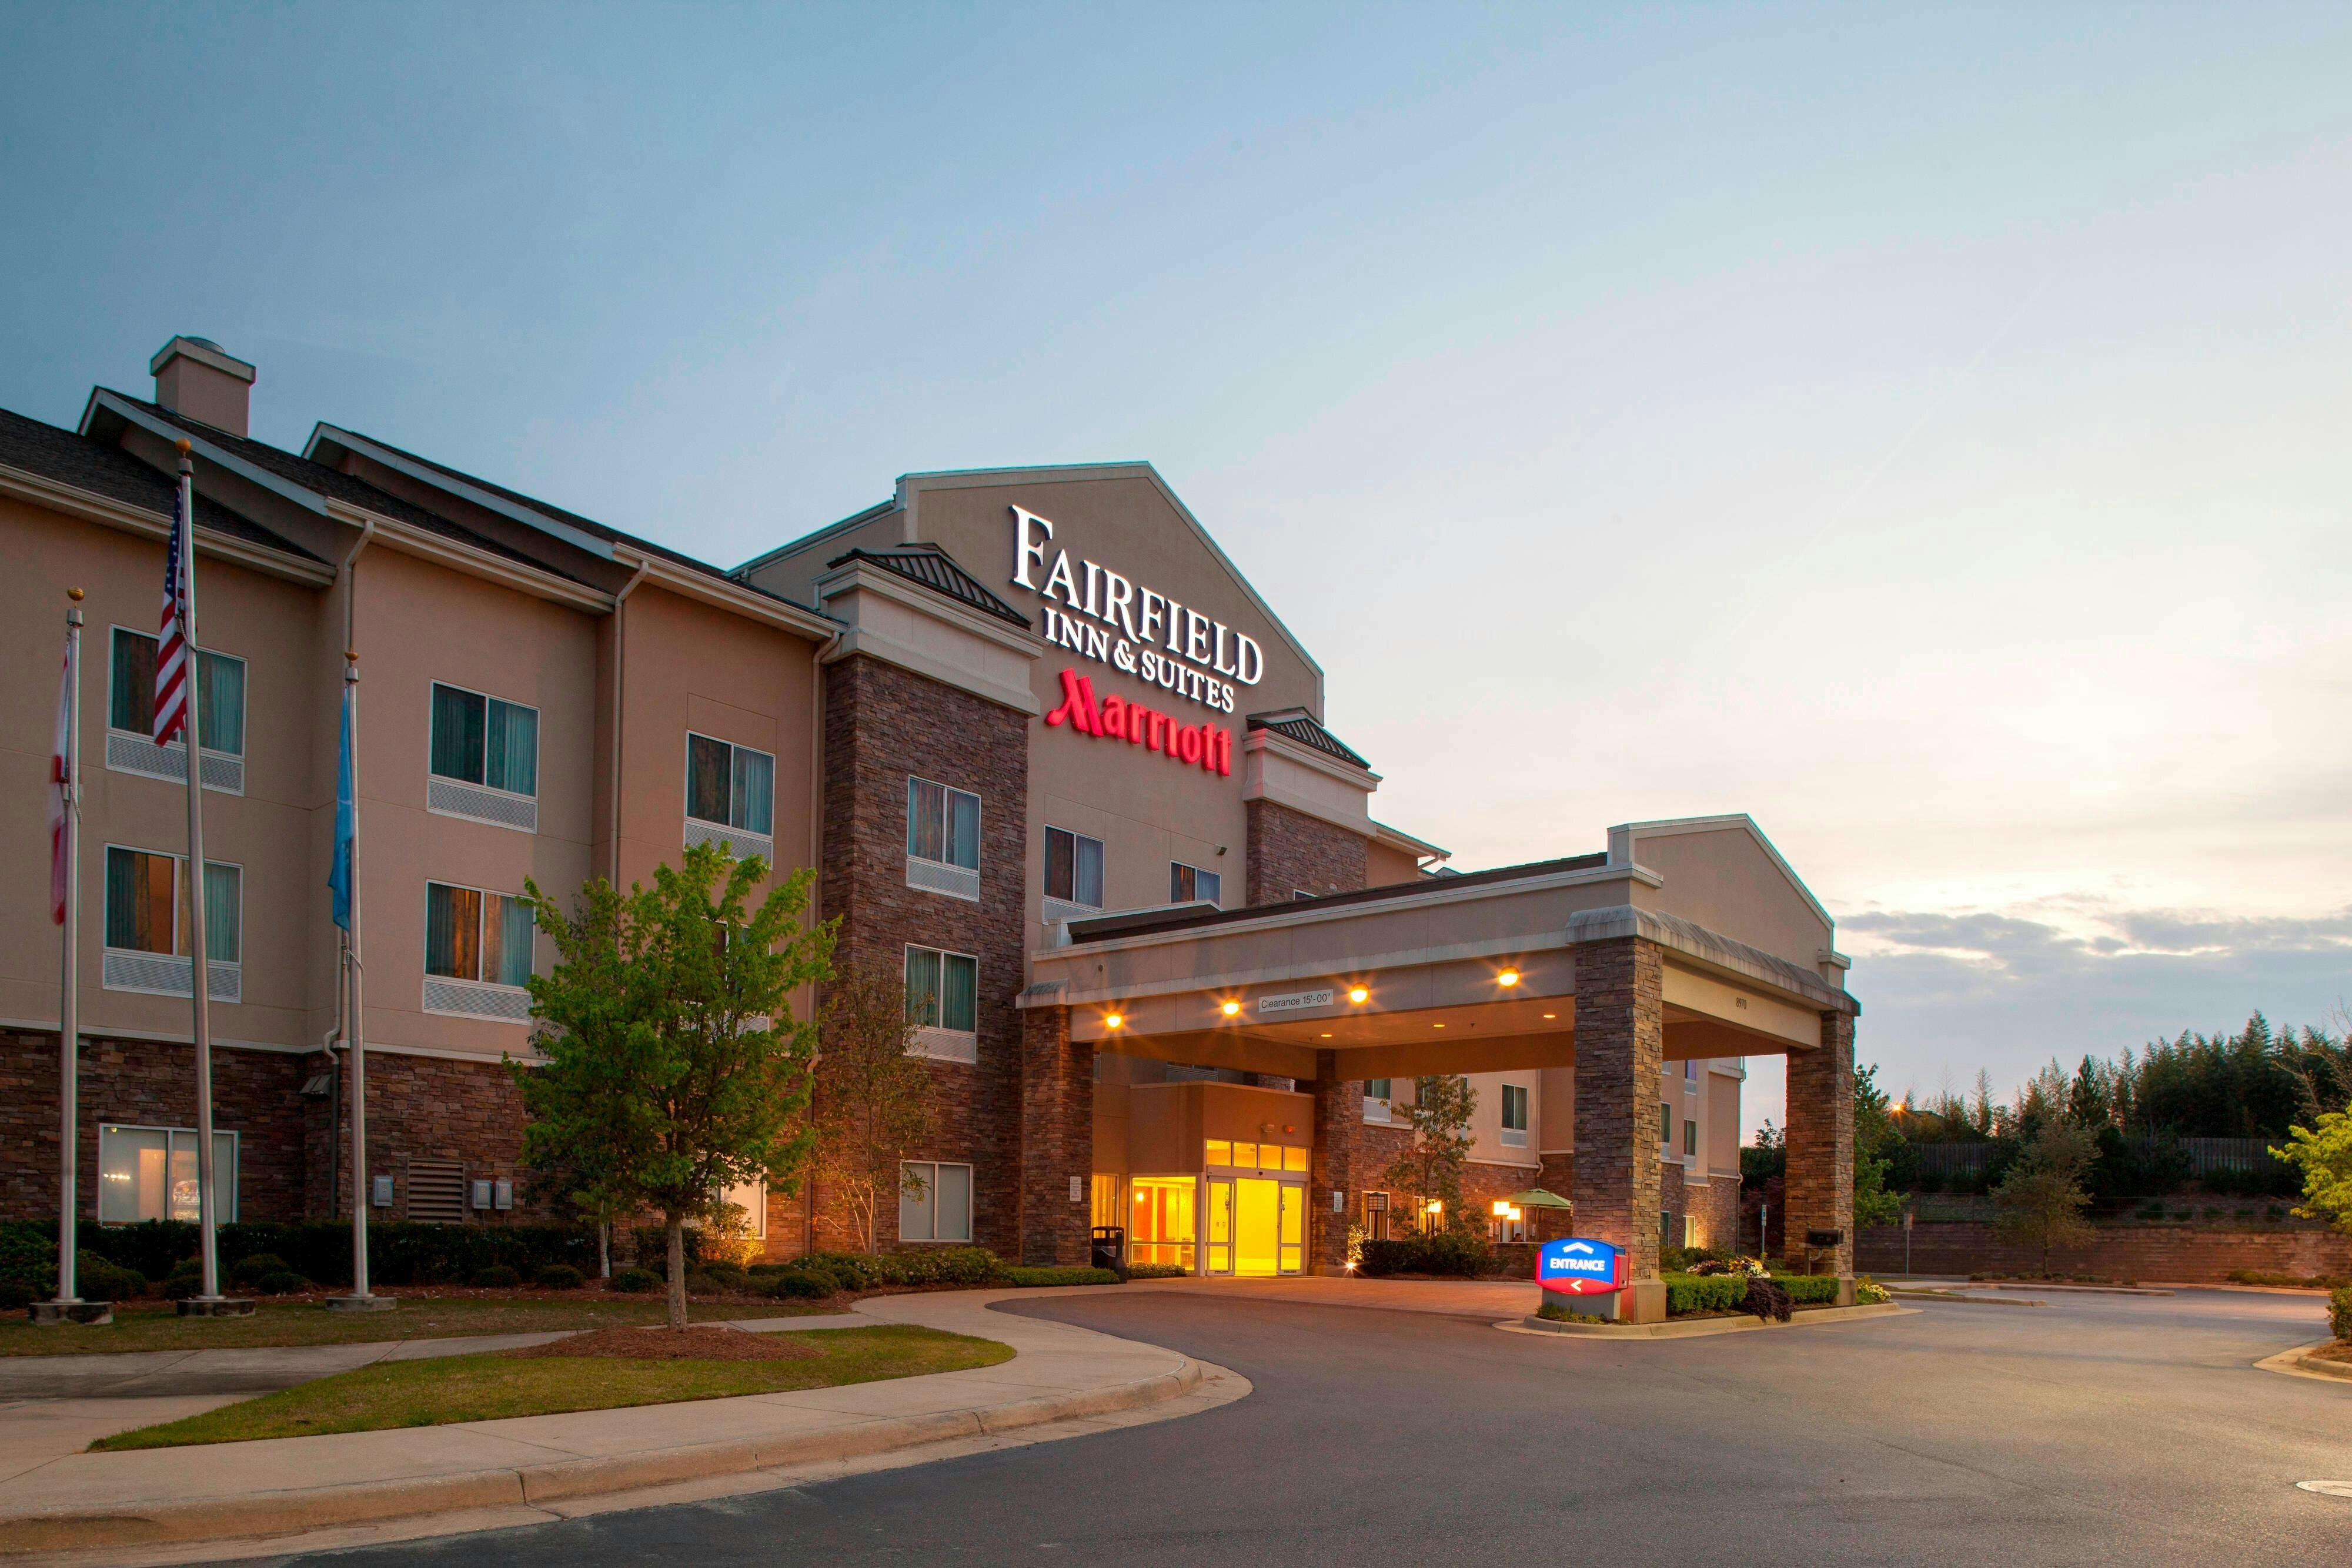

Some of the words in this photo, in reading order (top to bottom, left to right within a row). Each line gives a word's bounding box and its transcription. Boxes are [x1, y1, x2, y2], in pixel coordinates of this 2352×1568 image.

[1009, 504, 1264, 686] FAIRFIELD
[1043, 607, 1110, 663] INN
[1114, 639, 1138, 674] &
[1141, 650, 1235, 714] SUITES
[1045, 668, 1232, 777] Marriott
[1261, 998, 1300, 1008] Clearance
[1736, 997, 1746, 1010] 8970
[1550, 1258, 1605, 1271] ENTRANCE
